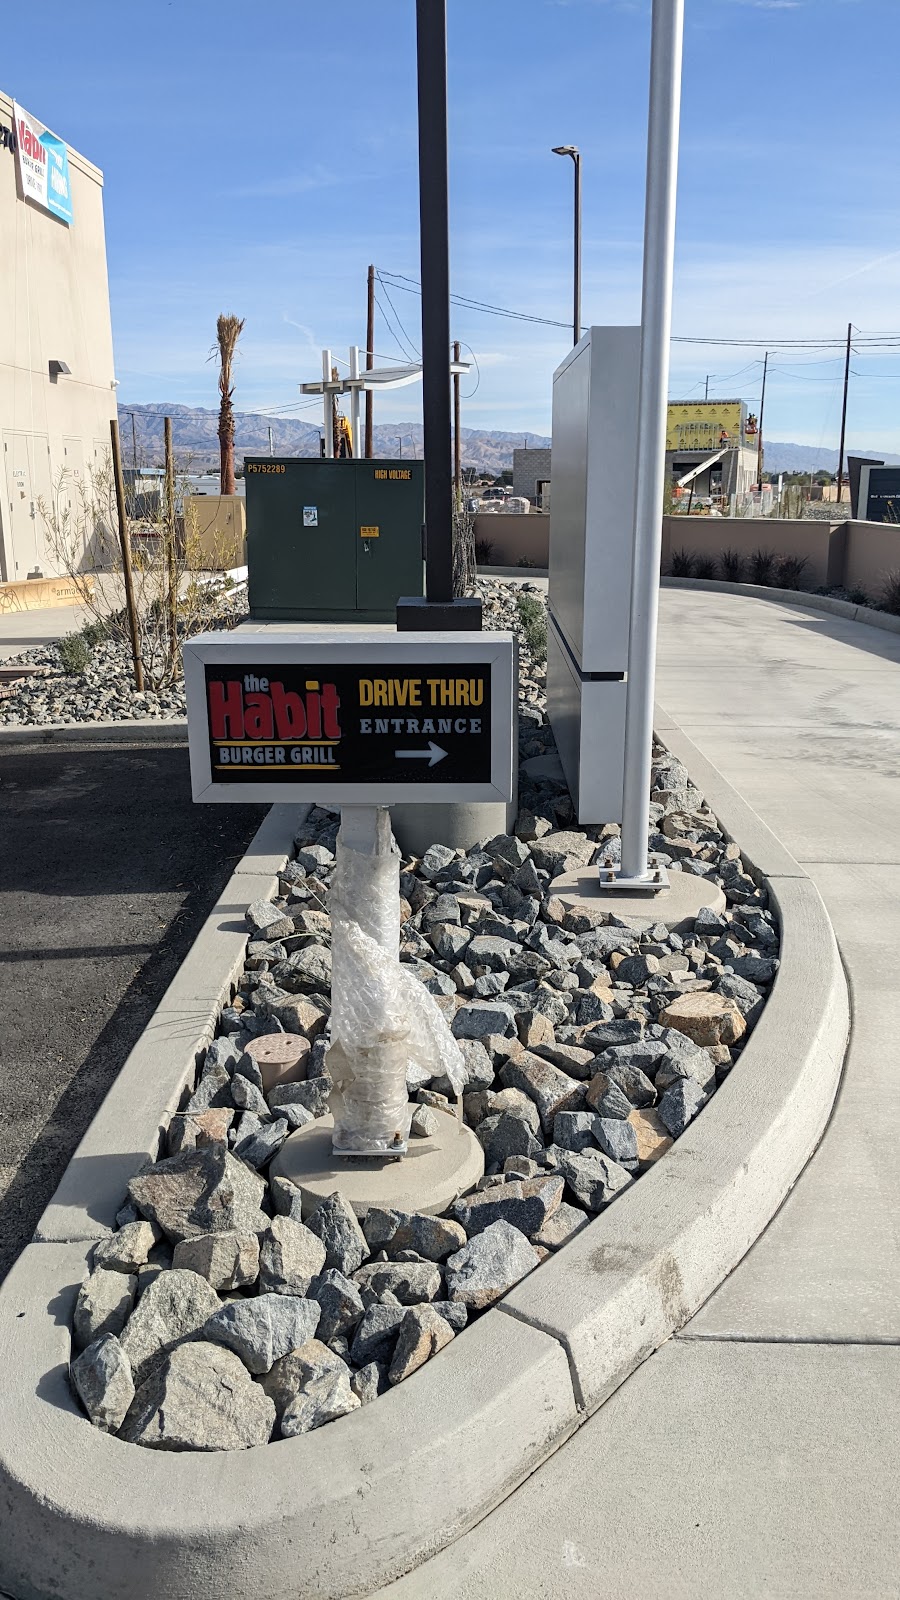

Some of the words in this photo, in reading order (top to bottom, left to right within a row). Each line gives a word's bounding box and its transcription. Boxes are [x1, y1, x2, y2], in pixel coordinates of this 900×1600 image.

[247, 464, 286, 473] P5752289
[374, 469, 388, 480] HIGH
[388, 469, 411, 480] VOLTAGE
[244, 674, 269, 692] the
[359, 679, 422, 706] DRIVE
[427, 678, 484, 706] THRU
[209, 680, 341, 740] Habit
[360, 718, 482, 734] ENTRANCE
[220, 747, 285, 763] BURGER
[290, 746, 336, 763] GRILL
